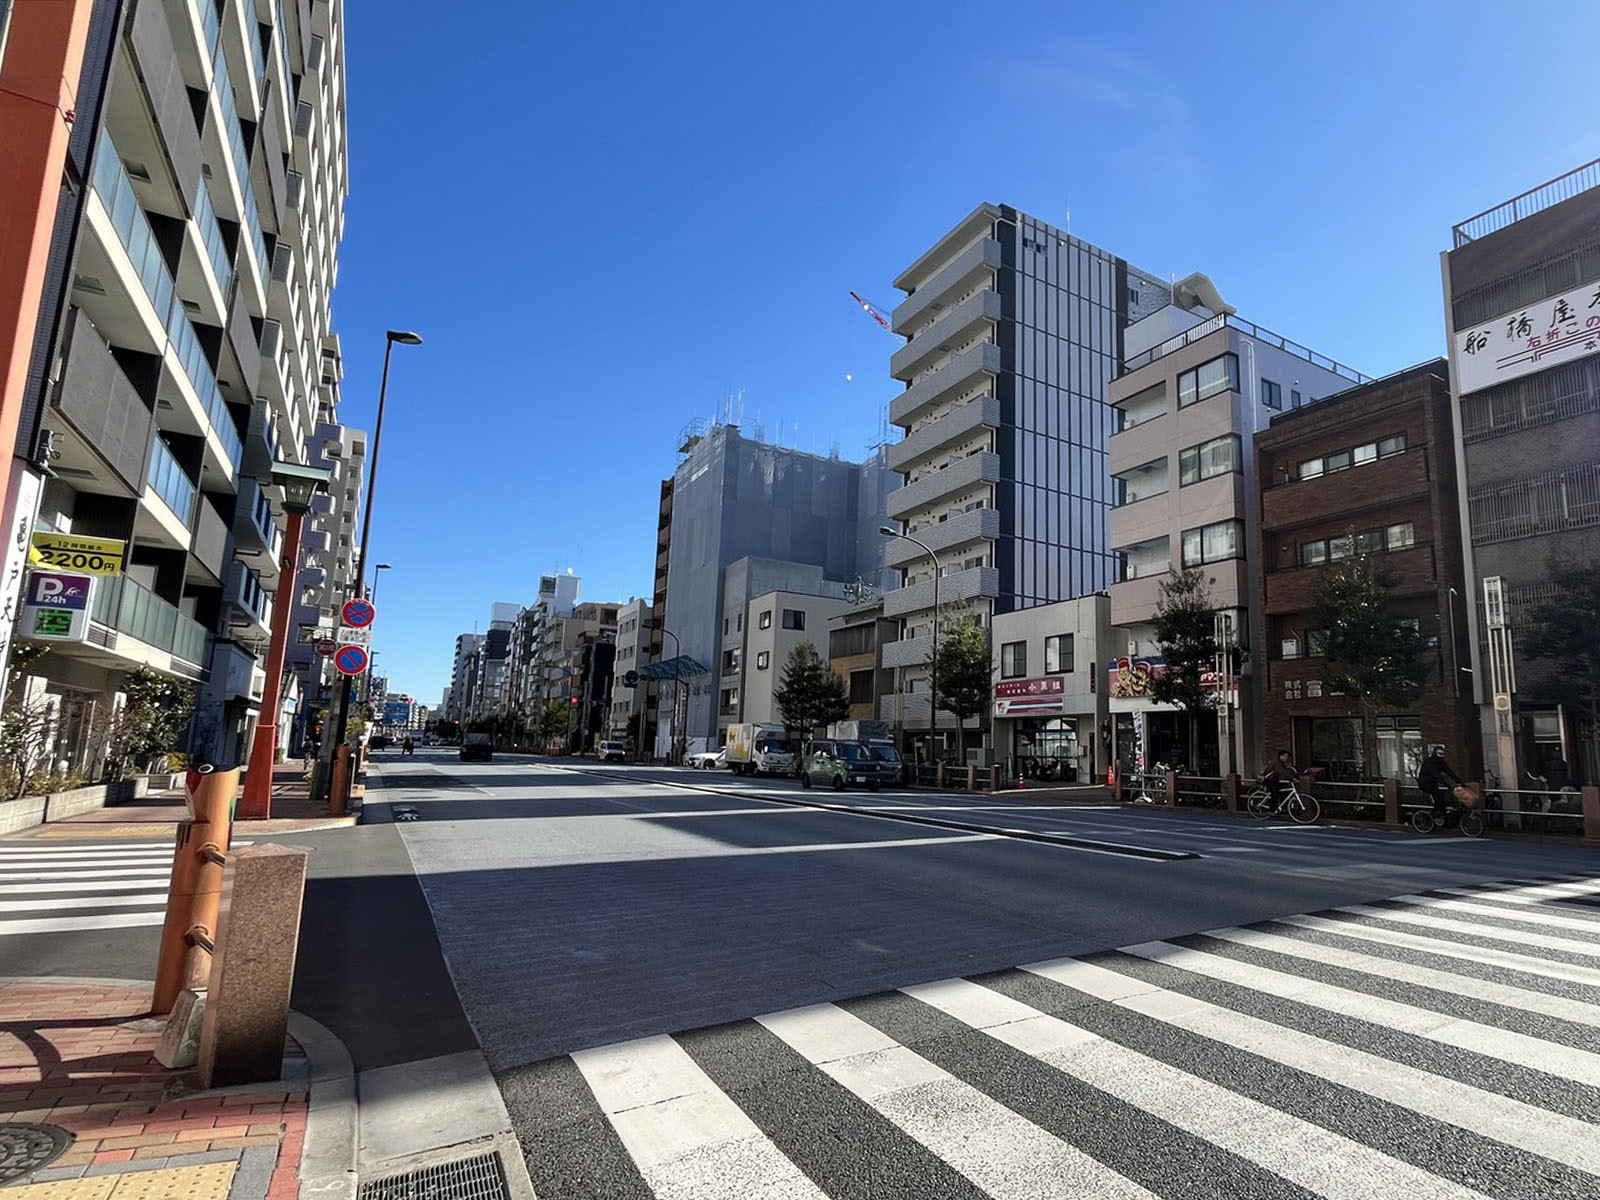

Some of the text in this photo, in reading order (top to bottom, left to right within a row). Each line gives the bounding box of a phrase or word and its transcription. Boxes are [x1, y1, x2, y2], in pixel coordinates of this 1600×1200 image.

[38, 551, 115, 572] 2200円
[35, 577, 64, 602] P
[43, 594, 66, 604] 24h
